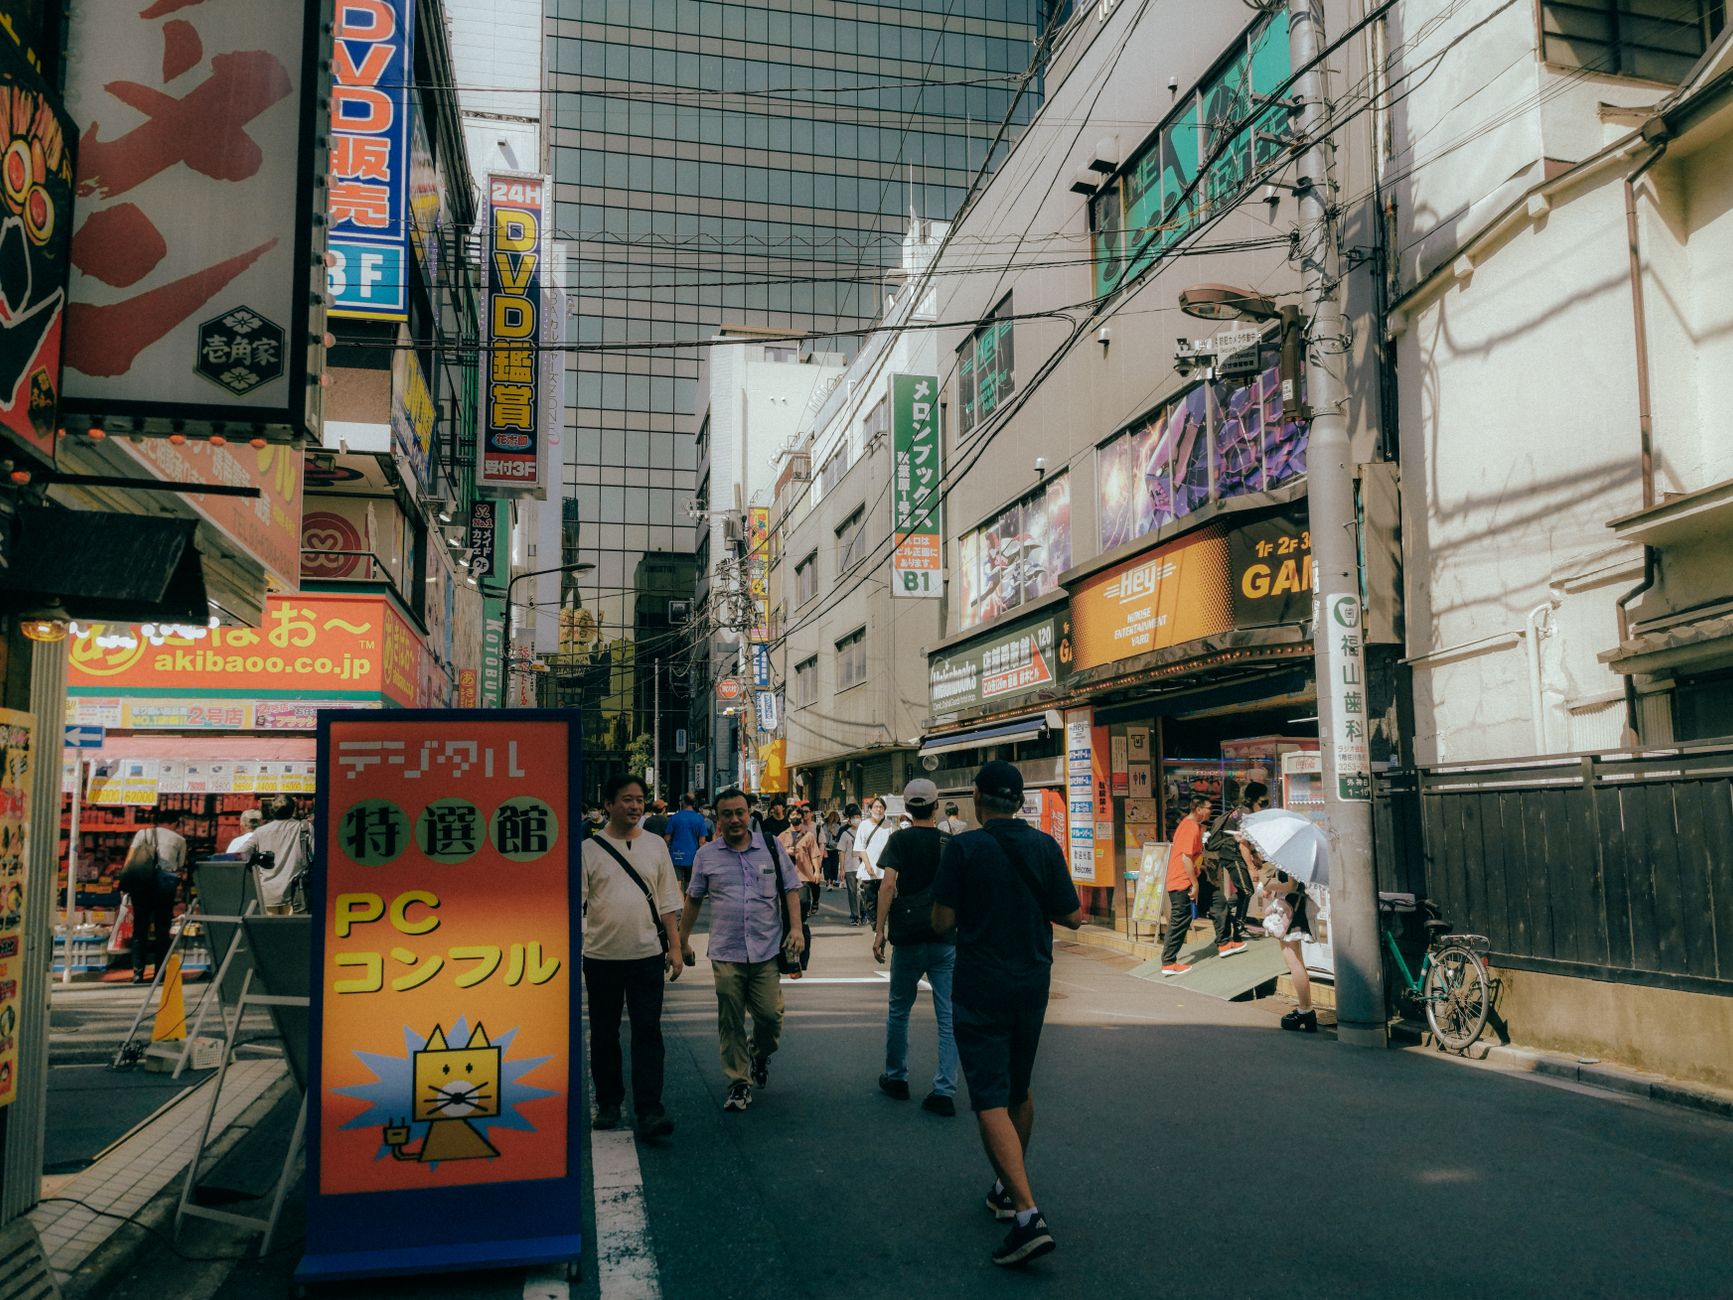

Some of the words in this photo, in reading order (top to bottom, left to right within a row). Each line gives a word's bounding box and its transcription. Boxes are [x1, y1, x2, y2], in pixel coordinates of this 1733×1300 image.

[491, 181, 541, 205] 24H
[492, 208, 539, 431] DVD鑑賞
[202, 334, 279, 365] 壱角家
[485, 460, 536, 477] 受付3F
[912, 380, 933, 527] メロンブックス
[897, 451, 910, 528] 秋葉原1号店
[482, 529, 491, 556] メイド
[1256, 541, 1273, 558] 1F
[1278, 537, 1298, 554] 2F
[1301, 532, 1312, 549] 3
[904, 571, 930, 591] B1
[1120, 563, 1156, 604] Hey
[1038, 626, 1051, 646] 120
[154, 651, 370, 680] akibaoo.co.jp
[485, 618, 506, 707] KOTOBUK
[1341, 634, 1364, 743] 福山歯科
[188, 706, 243, 725] 2号店
[347, 805, 548, 857] 特選館
[335, 890, 440, 938] PC
[334, 941, 561, 994] コンフル
